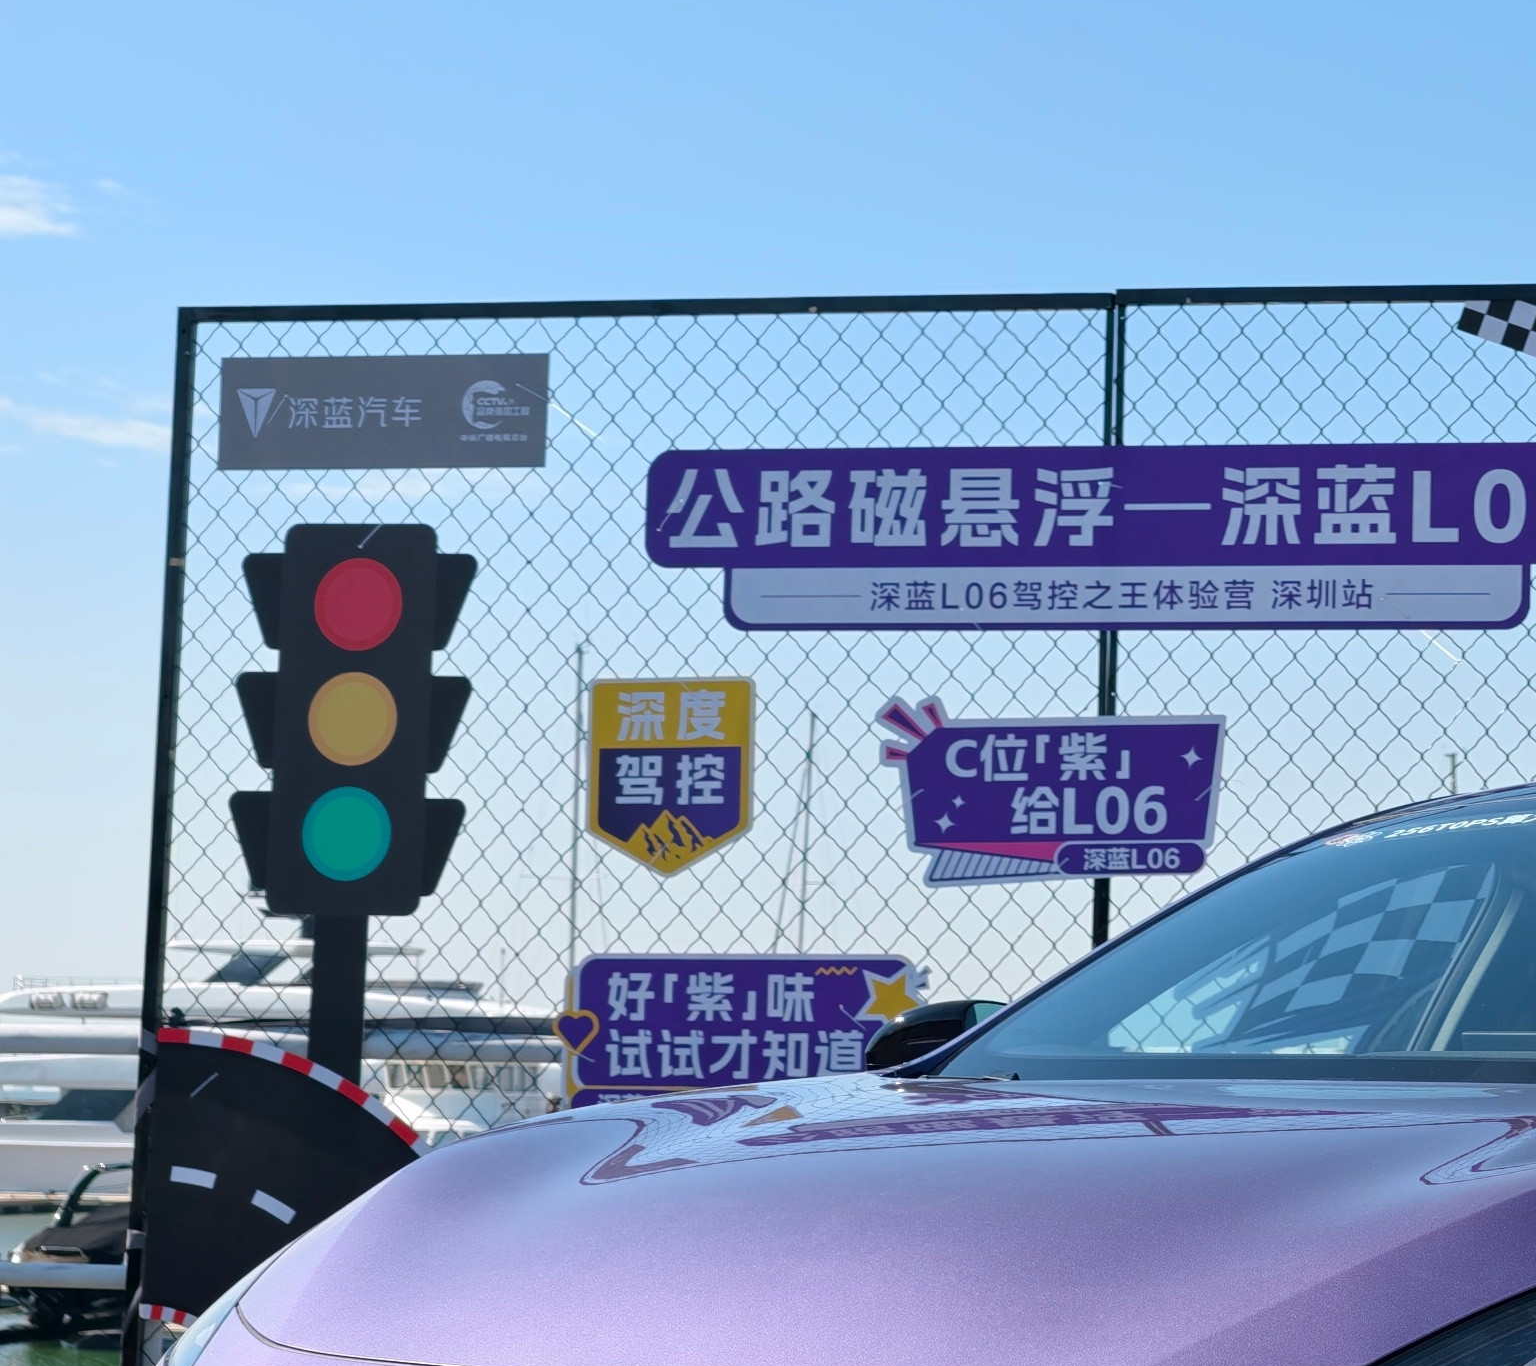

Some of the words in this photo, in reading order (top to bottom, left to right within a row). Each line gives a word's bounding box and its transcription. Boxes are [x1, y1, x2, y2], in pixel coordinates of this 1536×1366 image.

[288, 396, 422, 429] 深蓝汽车
[869, 577, 1256, 613] 深蓝L06驾控之王体验营
[1271, 577, 1375, 611] 深圳站
[617, 689, 727, 742] 深度
[615, 753, 725, 806] 驾控
[1010, 785, 1168, 835] 给L06
[1083, 847, 1181, 872] 深蓝L06
[605, 1028, 865, 1080] 试试才知道
